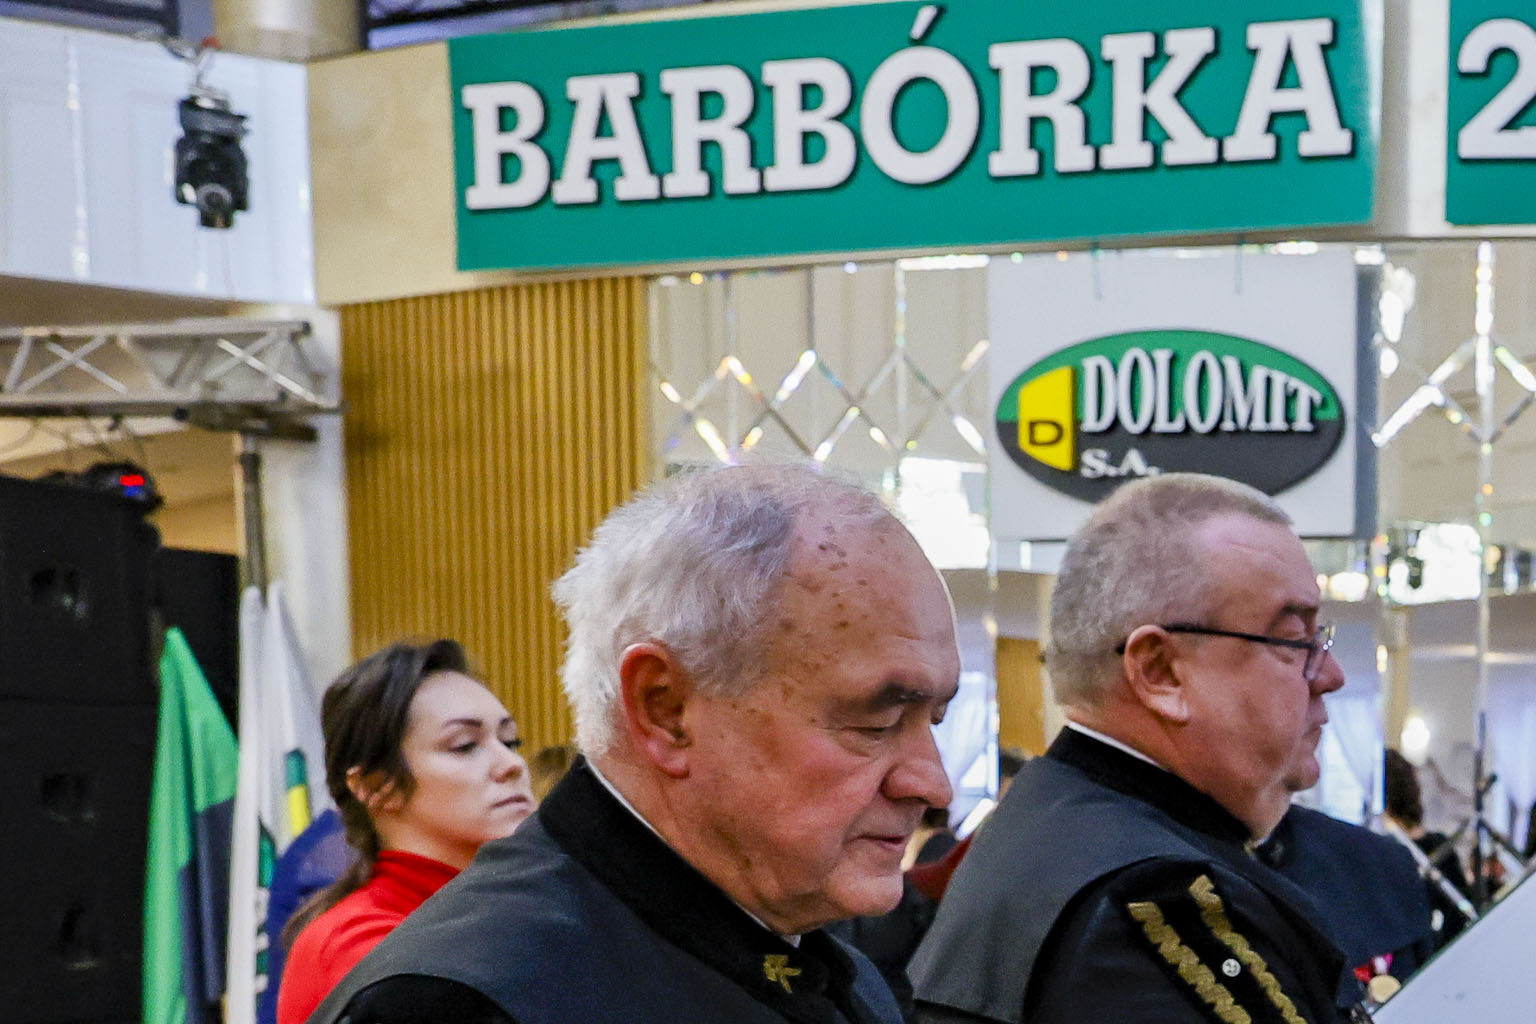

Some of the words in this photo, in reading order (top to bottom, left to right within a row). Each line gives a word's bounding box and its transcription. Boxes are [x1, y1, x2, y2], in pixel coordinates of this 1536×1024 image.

[463, 6, 1354, 209] BARBÓRKA
[1081, 347, 1323, 434] DOLOMIT
[1028, 419, 1065, 447] D
[1081, 448, 1160, 479] S.A.
